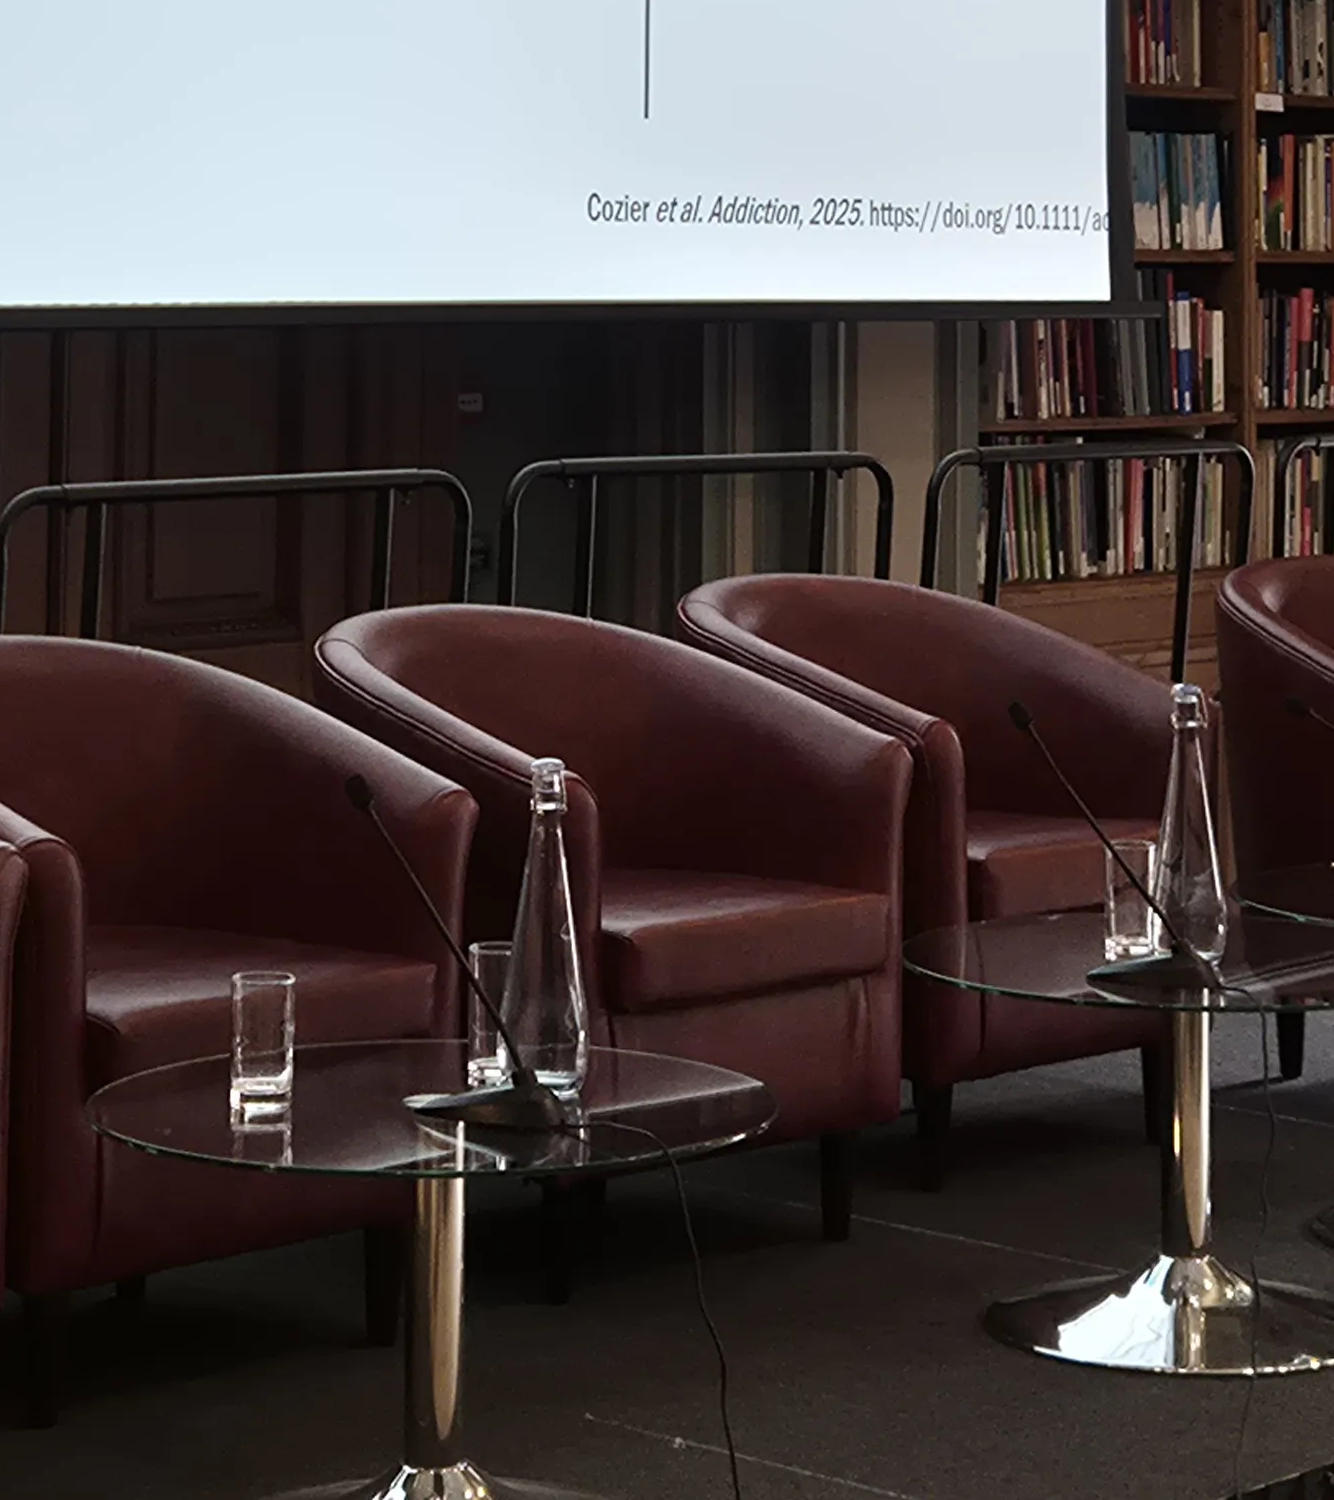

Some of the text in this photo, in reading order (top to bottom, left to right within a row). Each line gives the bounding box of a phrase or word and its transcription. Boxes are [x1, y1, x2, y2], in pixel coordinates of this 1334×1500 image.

[587, 192, 651, 224] Cozier
[656, 196, 677, 223] et
[680, 195, 704, 224] al.
[708, 195, 804, 230] Addiction,
[810, 198, 865, 228] 2025.
